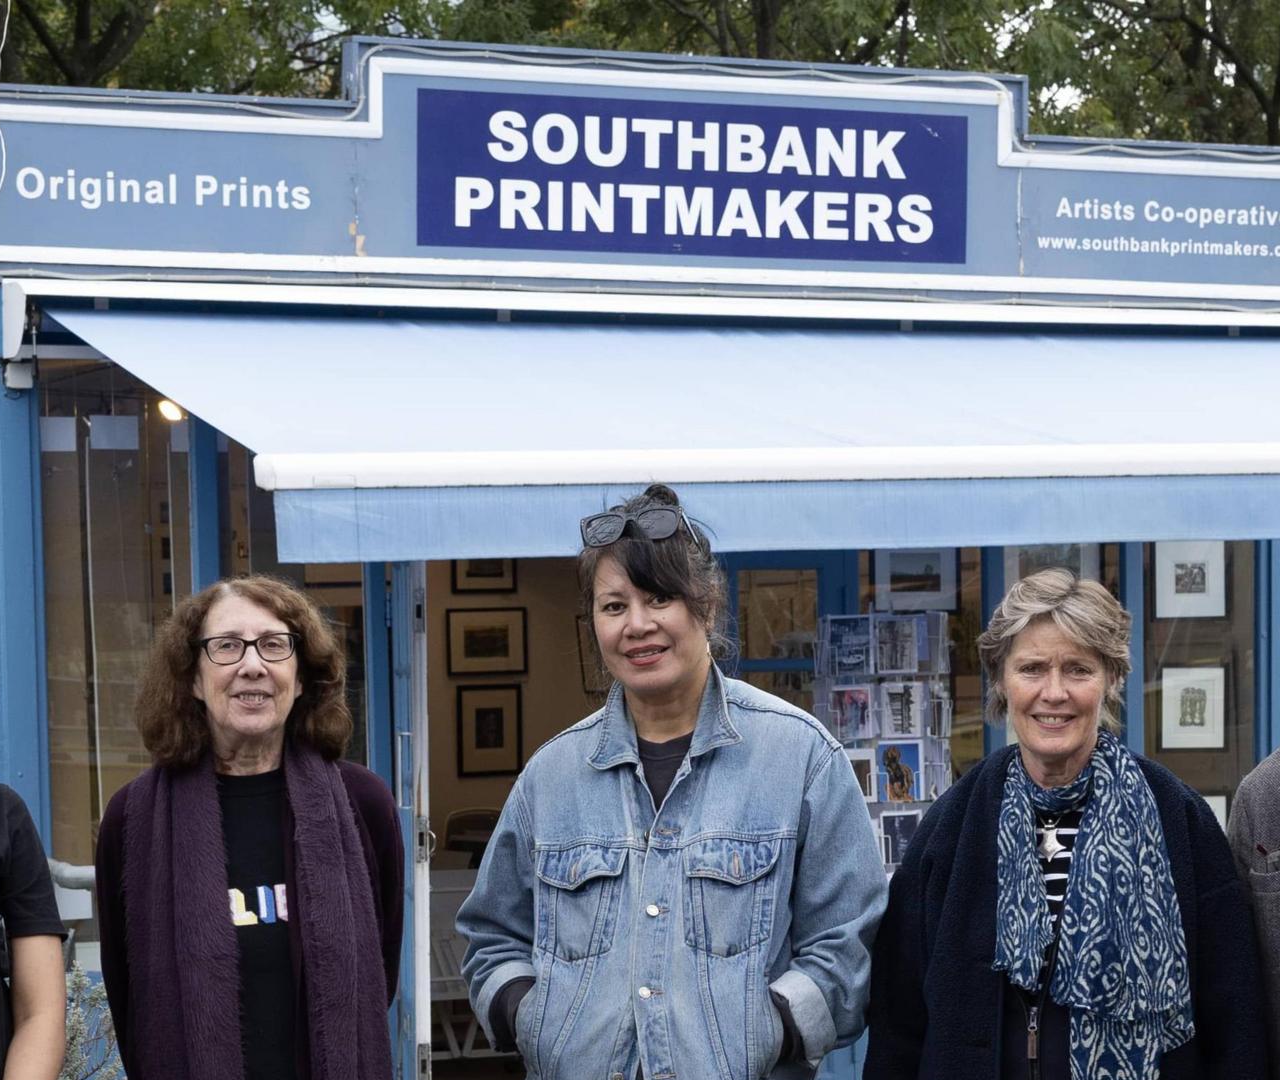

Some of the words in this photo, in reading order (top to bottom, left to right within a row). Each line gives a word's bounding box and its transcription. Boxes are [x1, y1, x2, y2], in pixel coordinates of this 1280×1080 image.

[486, 109, 907, 180] SOUTHBANK
[16, 166, 177, 210] Original
[194, 174, 312, 211] Prints
[453, 175, 935, 244] PRINTMAKERS
[1055, 197, 1136, 222] Artists
